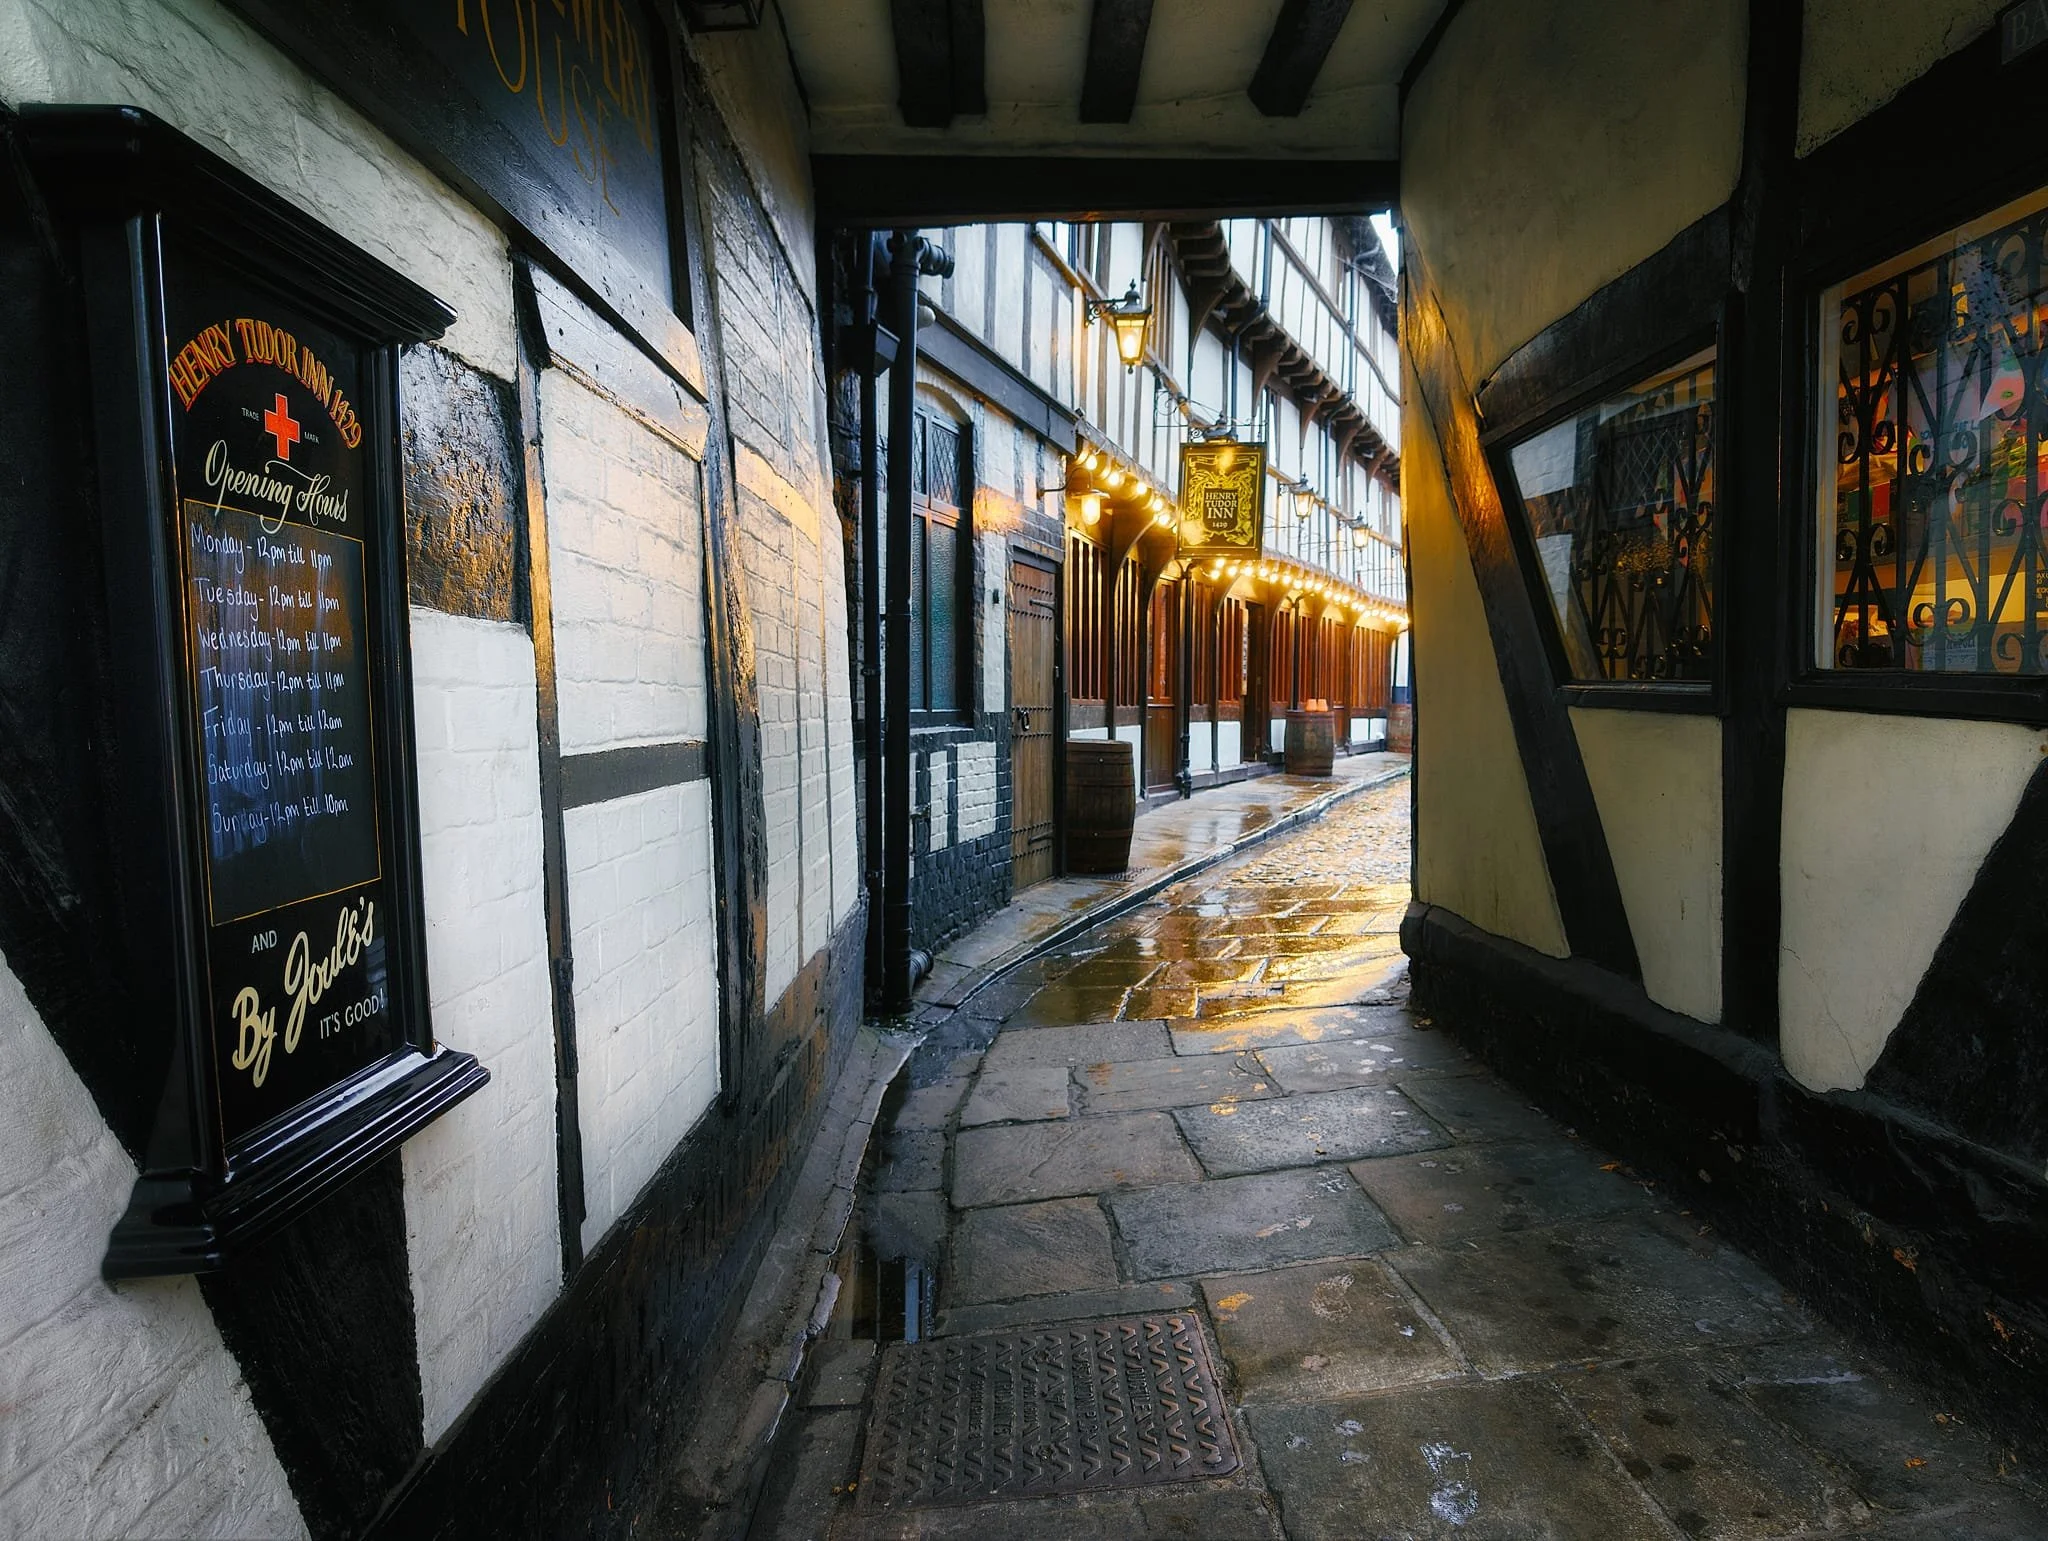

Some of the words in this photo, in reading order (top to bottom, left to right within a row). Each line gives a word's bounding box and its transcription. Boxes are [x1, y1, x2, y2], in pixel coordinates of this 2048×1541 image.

[457, 0, 621, 218] OUSE
[168, 319, 238, 412] HENRY
[235, 318, 301, 377] TUDOR
[300, 344, 334, 409] INN
[326, 388, 364, 450] 1429
[241, 407, 260, 421] TRADE
[304, 431, 320, 445] MARK
[204, 439, 294, 535] Opening
[278, 462, 349, 527] Hours
[1204, 500, 1237, 508] TUDOR
[1205, 492, 1237, 500] HENRY
[1207, 508, 1234, 519] INN
[191, 522, 245, 574] Monday
[257, 535, 286, 567] 12pm
[288, 543, 306, 564] till
[310, 549, 332, 571] 11pm
[269, 584, 295, 611] 12pm
[298, 589, 313, 609] till
[318, 590, 340, 613] 11pm
[305, 630, 320, 652] till
[323, 631, 342, 653] 11pm
[306, 671, 322, 690] till
[325, 671, 345, 693] 11pm
[203, 705, 253, 747] Friday
[265, 713, 294, 738] 12pm
[298, 713, 315, 732] till
[317, 709, 343, 730] 12am
[276, 750, 305, 777] 12pm
[306, 748, 323, 769] till
[325, 745, 354, 770] 12am
[302, 796, 321, 817] till
[324, 793, 349, 817] 10pm
[252, 930, 277, 953] AND
[232, 986, 277, 1088] By
[284, 896, 374, 1054] Joule's
[320, 1011, 341, 1040] IT'S
[345, 987, 385, 1027] GOOD!
[1125, 1367, 1151, 1415] DUCTILE
